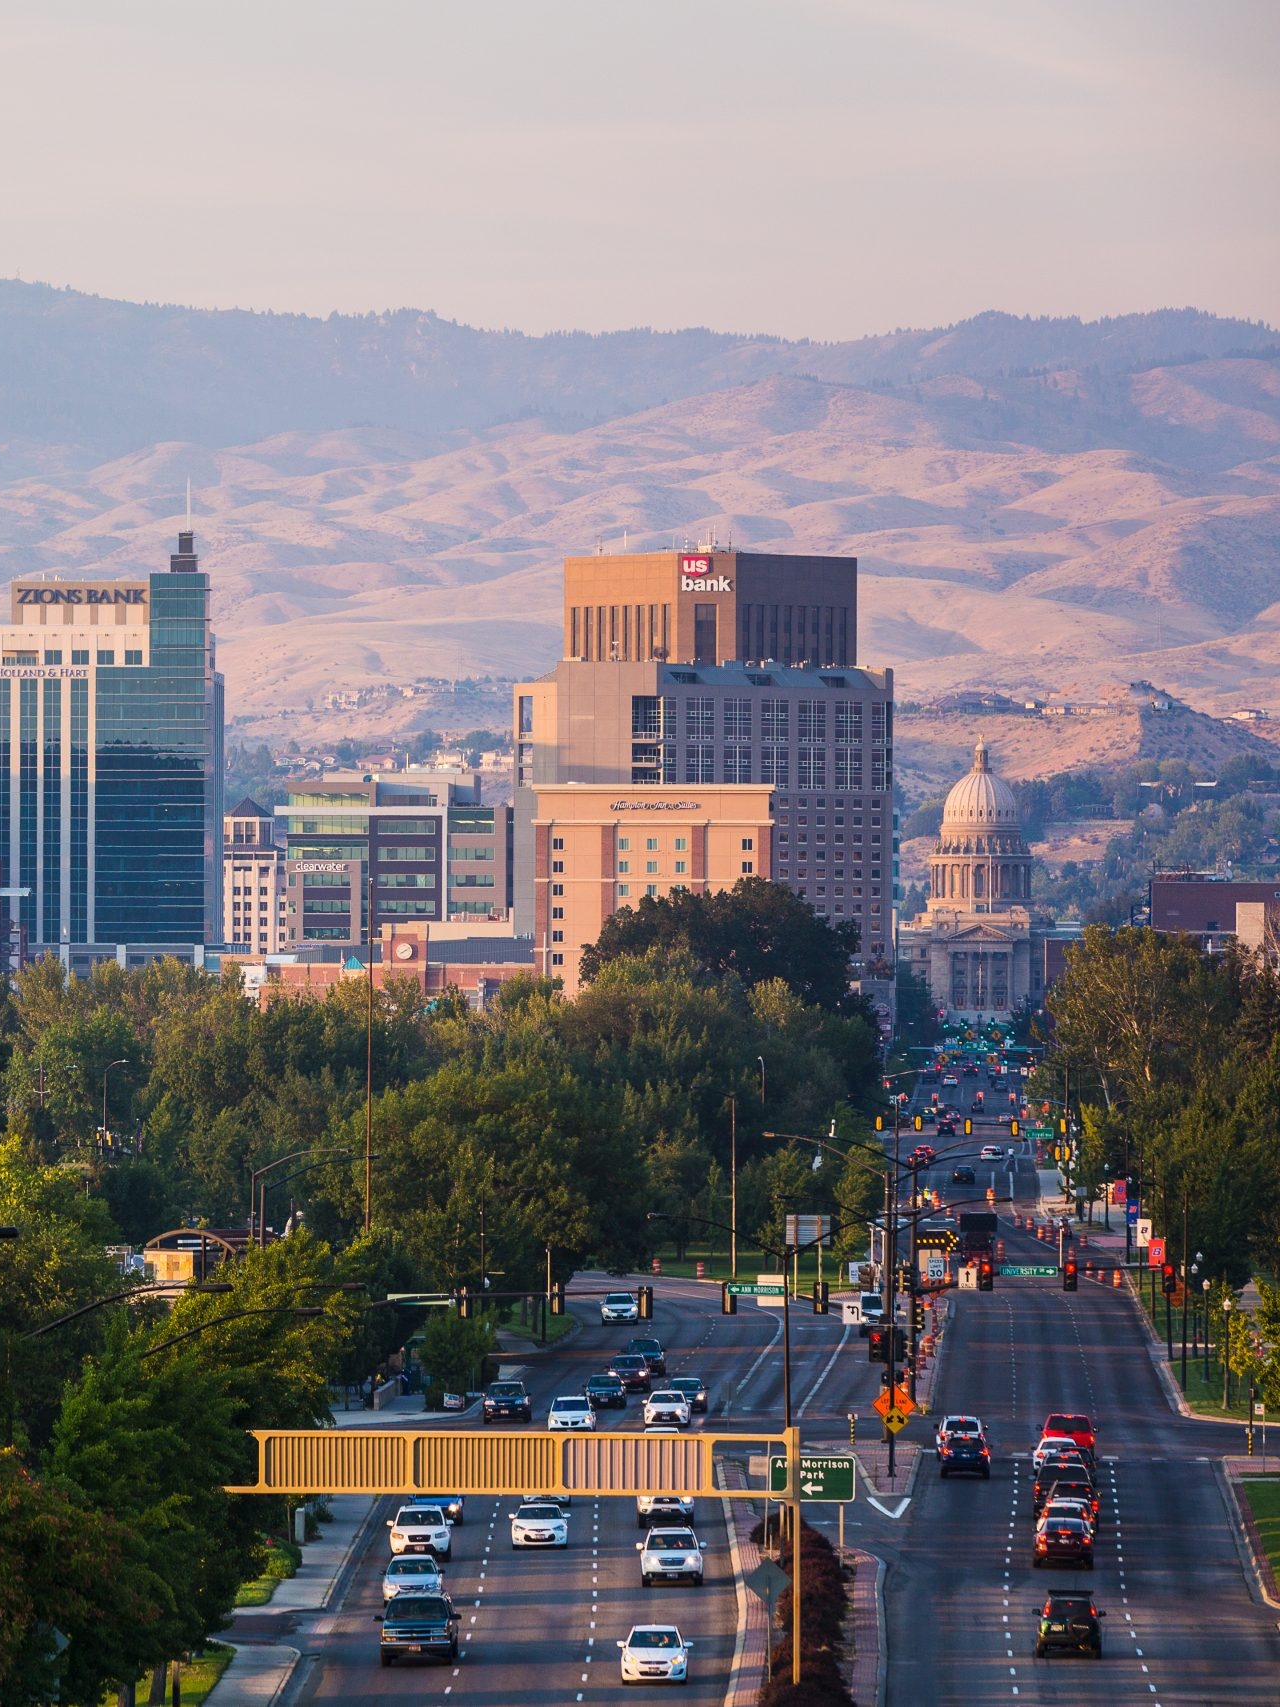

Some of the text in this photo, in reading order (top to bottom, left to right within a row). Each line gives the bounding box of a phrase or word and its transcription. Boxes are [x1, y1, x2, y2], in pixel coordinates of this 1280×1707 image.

[683, 559, 708, 573] us
[681, 575, 731, 592] bank
[17, 588, 148, 604] ZIONS BANK
[47, 668, 56, 678] &
[60, 668, 88, 678] HART
[613, 801, 647, 810] Hampton
[676, 801, 698, 810] Suites
[295, 861, 346, 871] clearwater
[929, 1269, 943, 1278] 30
[1002, 1268, 1037, 1276] UNIVERSITY
[741, 1286, 752, 1294] ANN
[754, 1286, 779, 1295] MORRISON
[802, 1460, 849, 1468] Morrison
[800, 1470, 824, 1479] Park
